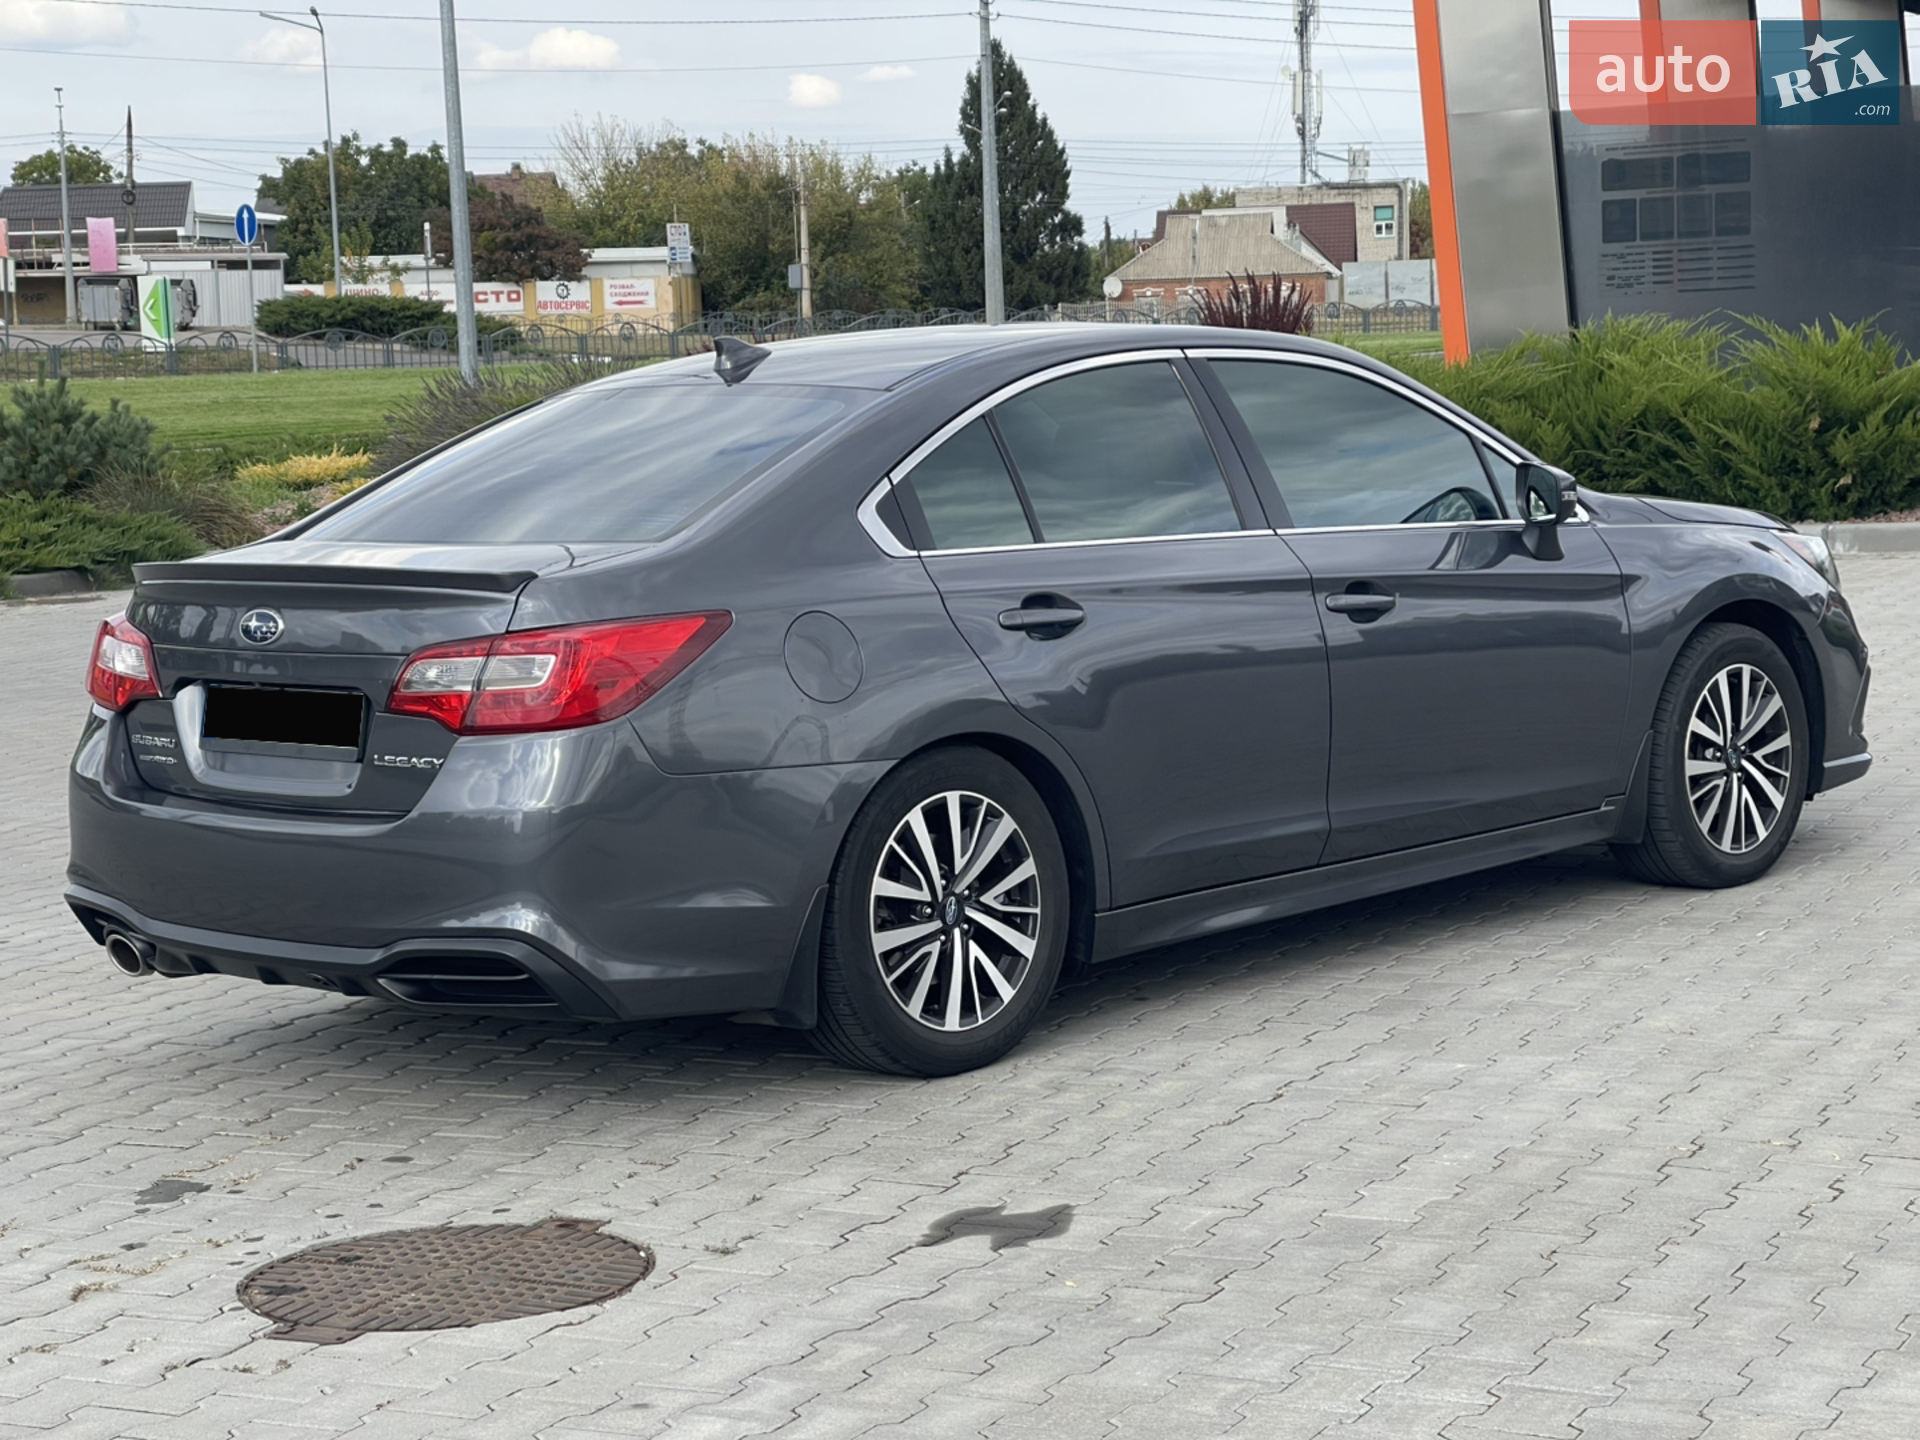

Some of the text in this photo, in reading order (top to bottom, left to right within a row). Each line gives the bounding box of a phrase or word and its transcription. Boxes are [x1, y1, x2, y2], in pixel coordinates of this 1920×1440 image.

[474, 290, 522, 303] СТО
[537, 300, 590, 311] АВТОСЕРВІС
[131, 734, 176, 749] SUBARU
[373, 754, 445, 769] LEGACY
